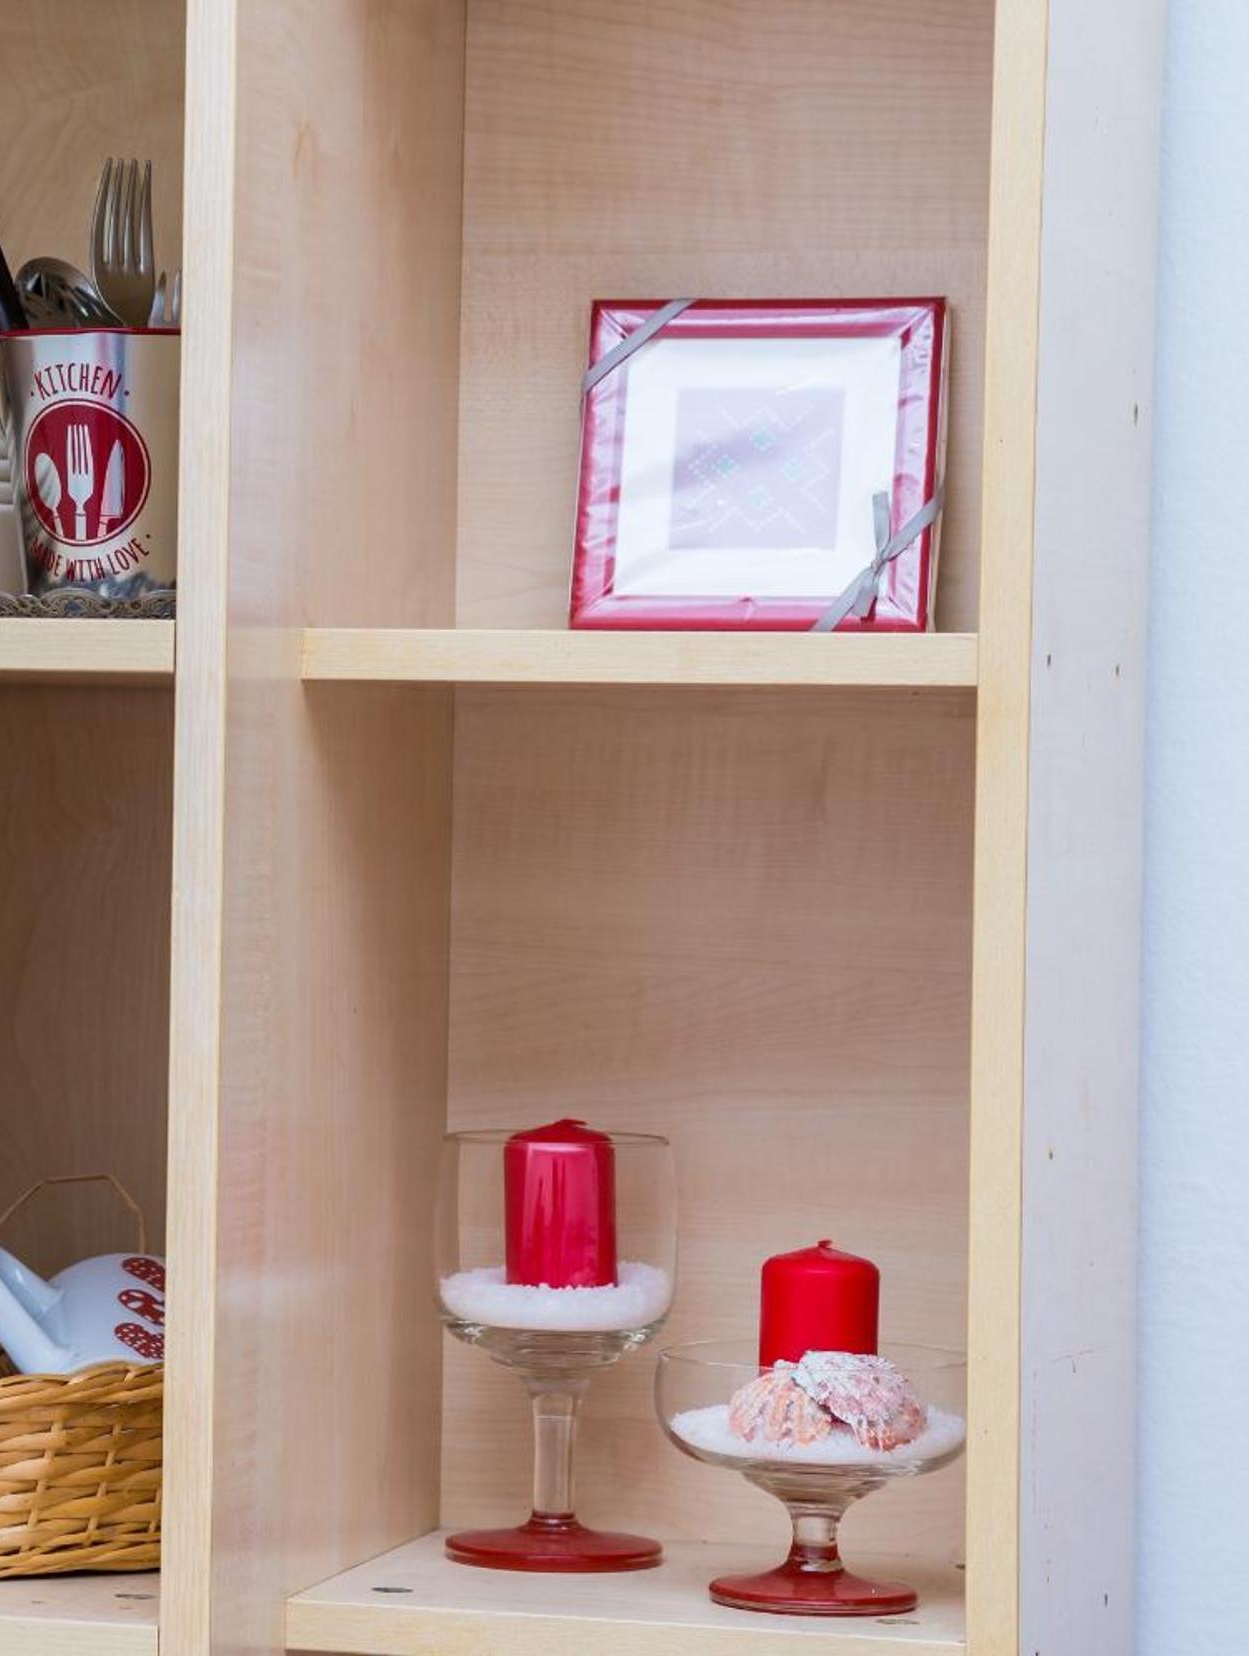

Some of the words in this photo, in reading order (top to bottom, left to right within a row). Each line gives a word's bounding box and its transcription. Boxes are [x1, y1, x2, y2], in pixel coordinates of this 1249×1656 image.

[34, 362, 123, 401] KITCHEN
[30, 538, 62, 577] MADE
[66, 559, 105, 582] WITH
[109, 537, 150, 576] LOVE
